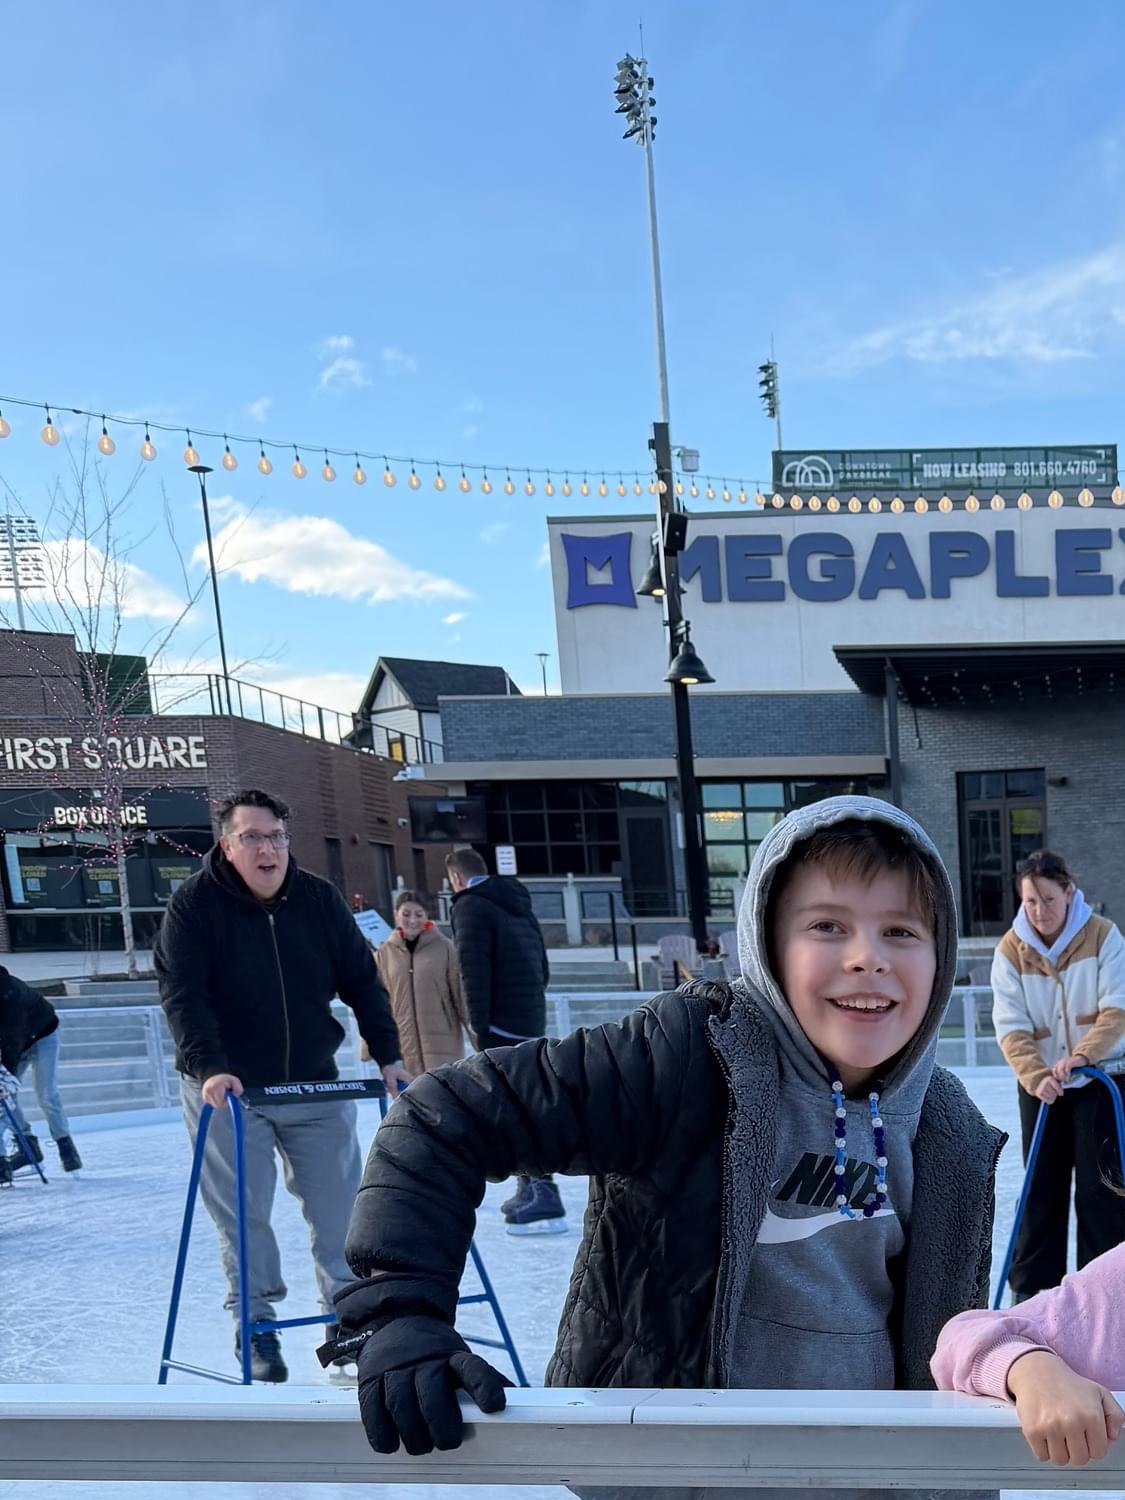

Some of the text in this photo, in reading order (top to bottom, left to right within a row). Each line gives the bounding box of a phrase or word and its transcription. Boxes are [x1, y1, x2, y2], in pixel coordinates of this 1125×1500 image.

[923, 460, 1097, 478] NOW LEASING 801.660.4760
[54, 806, 88, 825] BOX
[264, 1084, 303, 1095] JENSEN
[303, 1084, 314, 1094] &
[775, 1151, 881, 1210] NIKE
